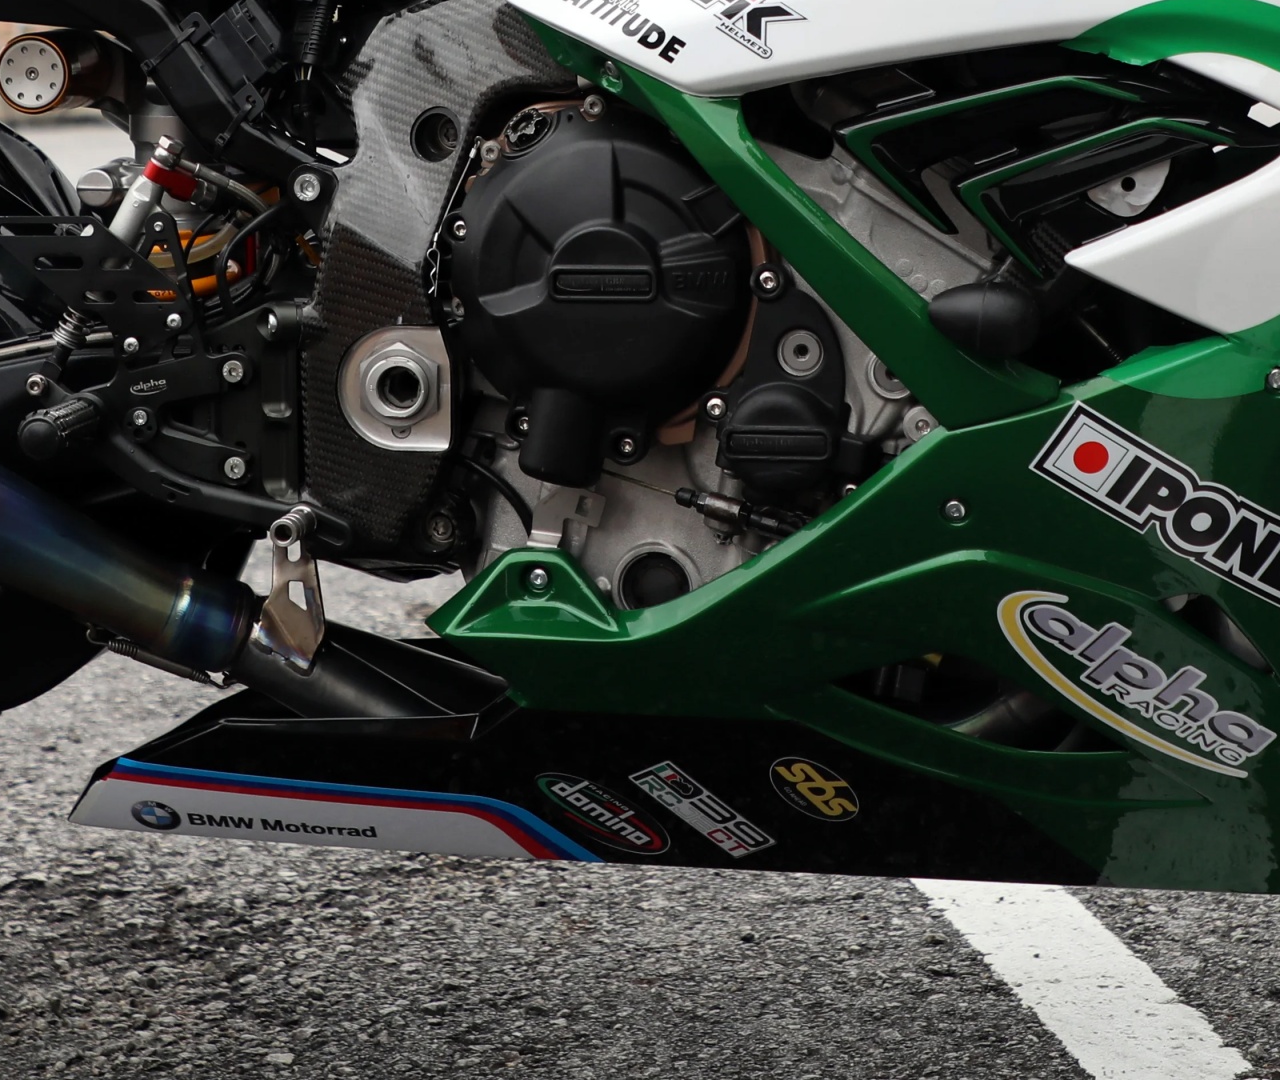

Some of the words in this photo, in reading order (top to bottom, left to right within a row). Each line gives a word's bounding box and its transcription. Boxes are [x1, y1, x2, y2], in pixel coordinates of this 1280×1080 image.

[720, 21, 770, 56] HELMETS
[132, 379, 167, 392] alpha
[1023, 604, 1278, 757] alpha
[1099, 683, 1246, 765] RACING
[587, 783, 630, 811] RACING
[775, 762, 857, 816] sbs
[187, 813, 253, 830] BMW
[260, 818, 378, 839] Motorrad
[550, 780, 651, 846] domino
